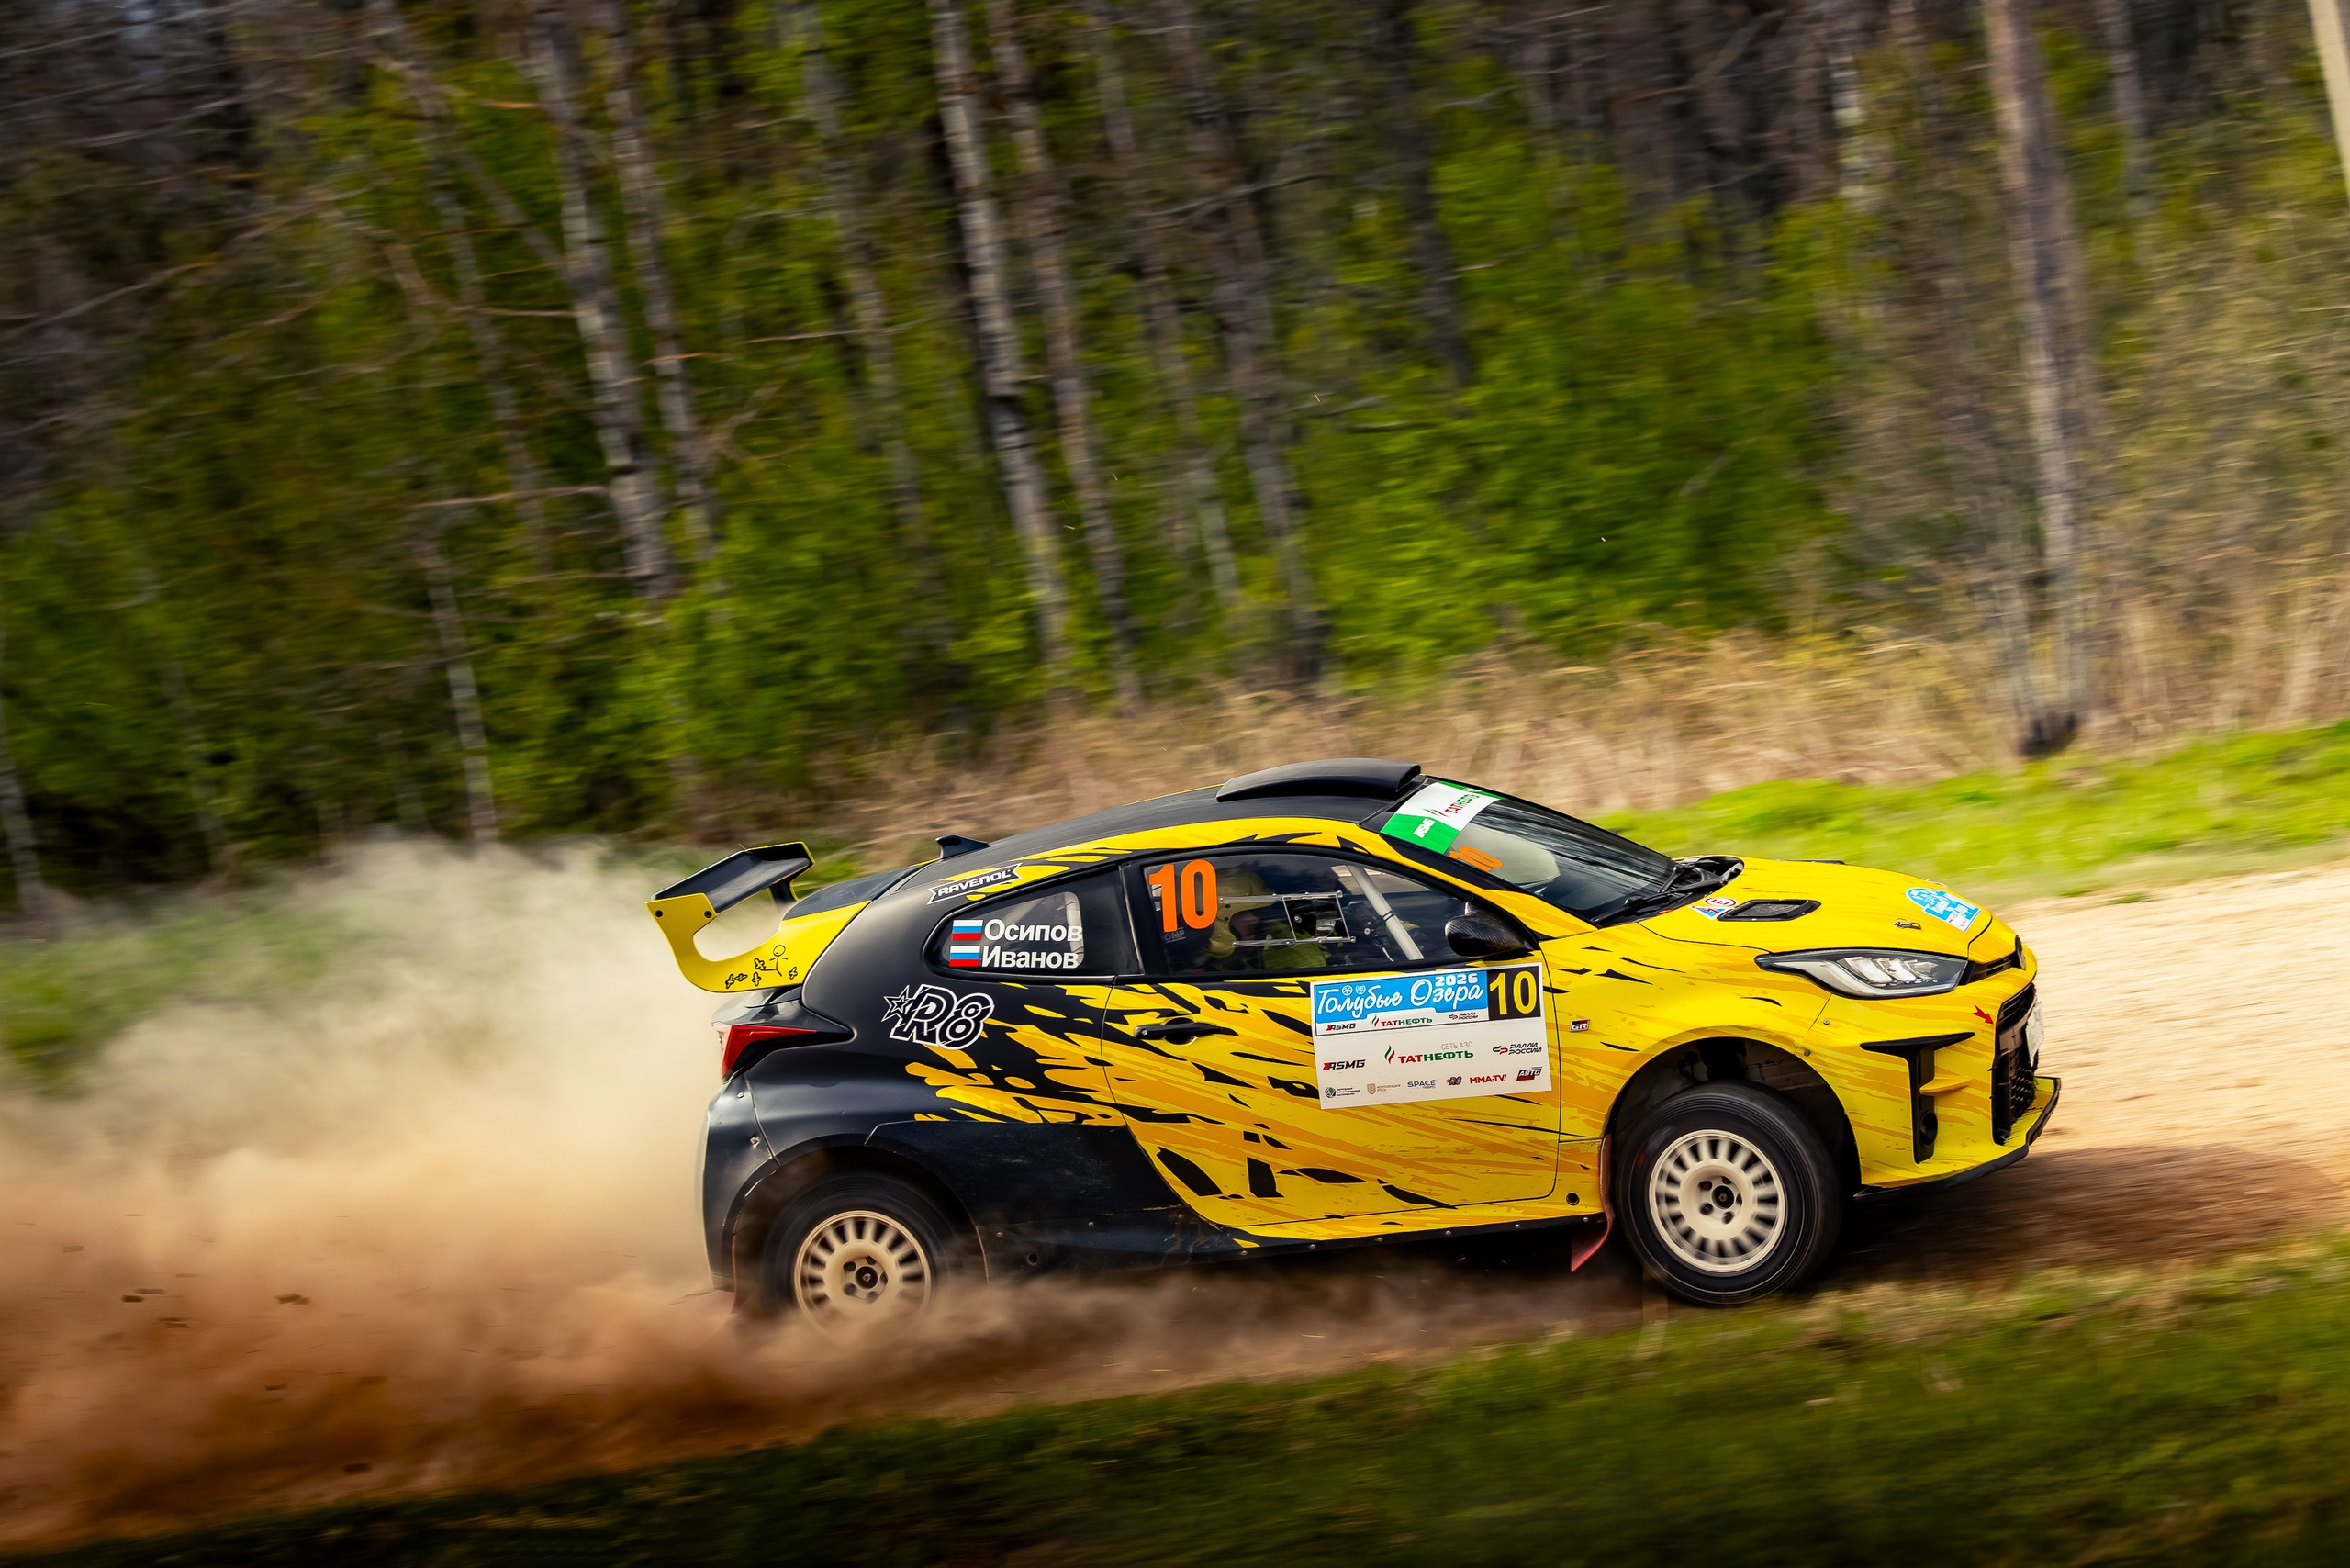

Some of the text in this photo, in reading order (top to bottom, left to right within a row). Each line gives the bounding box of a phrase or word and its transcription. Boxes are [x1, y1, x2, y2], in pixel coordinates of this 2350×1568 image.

[1449, 846, 1503, 872] 10
[938, 869, 1012, 896] RAVENOL
[1148, 859, 1218, 933] 10
[984, 919, 1083, 942] Осипов
[981, 946, 1080, 969] Иванов
[1435, 973, 1478, 987] 2026
[1318, 979, 1484, 1018] Голубые Озера
[1489, 970, 1538, 1015] 10
[889, 983, 995, 1050] R8
[1381, 1017, 1433, 1027] ТАТНЕФТЬ
[1571, 1023, 1588, 1031] GR
[1441, 1042, 1459, 1050] СЕТЬ
[1322, 1059, 1366, 1070] ASMG
[1398, 1050, 1474, 1064] ТАТНЕФТЬ
[1407, 1080, 1437, 1088] SPACE
[1470, 1074, 1507, 1084] MMA-TV!
